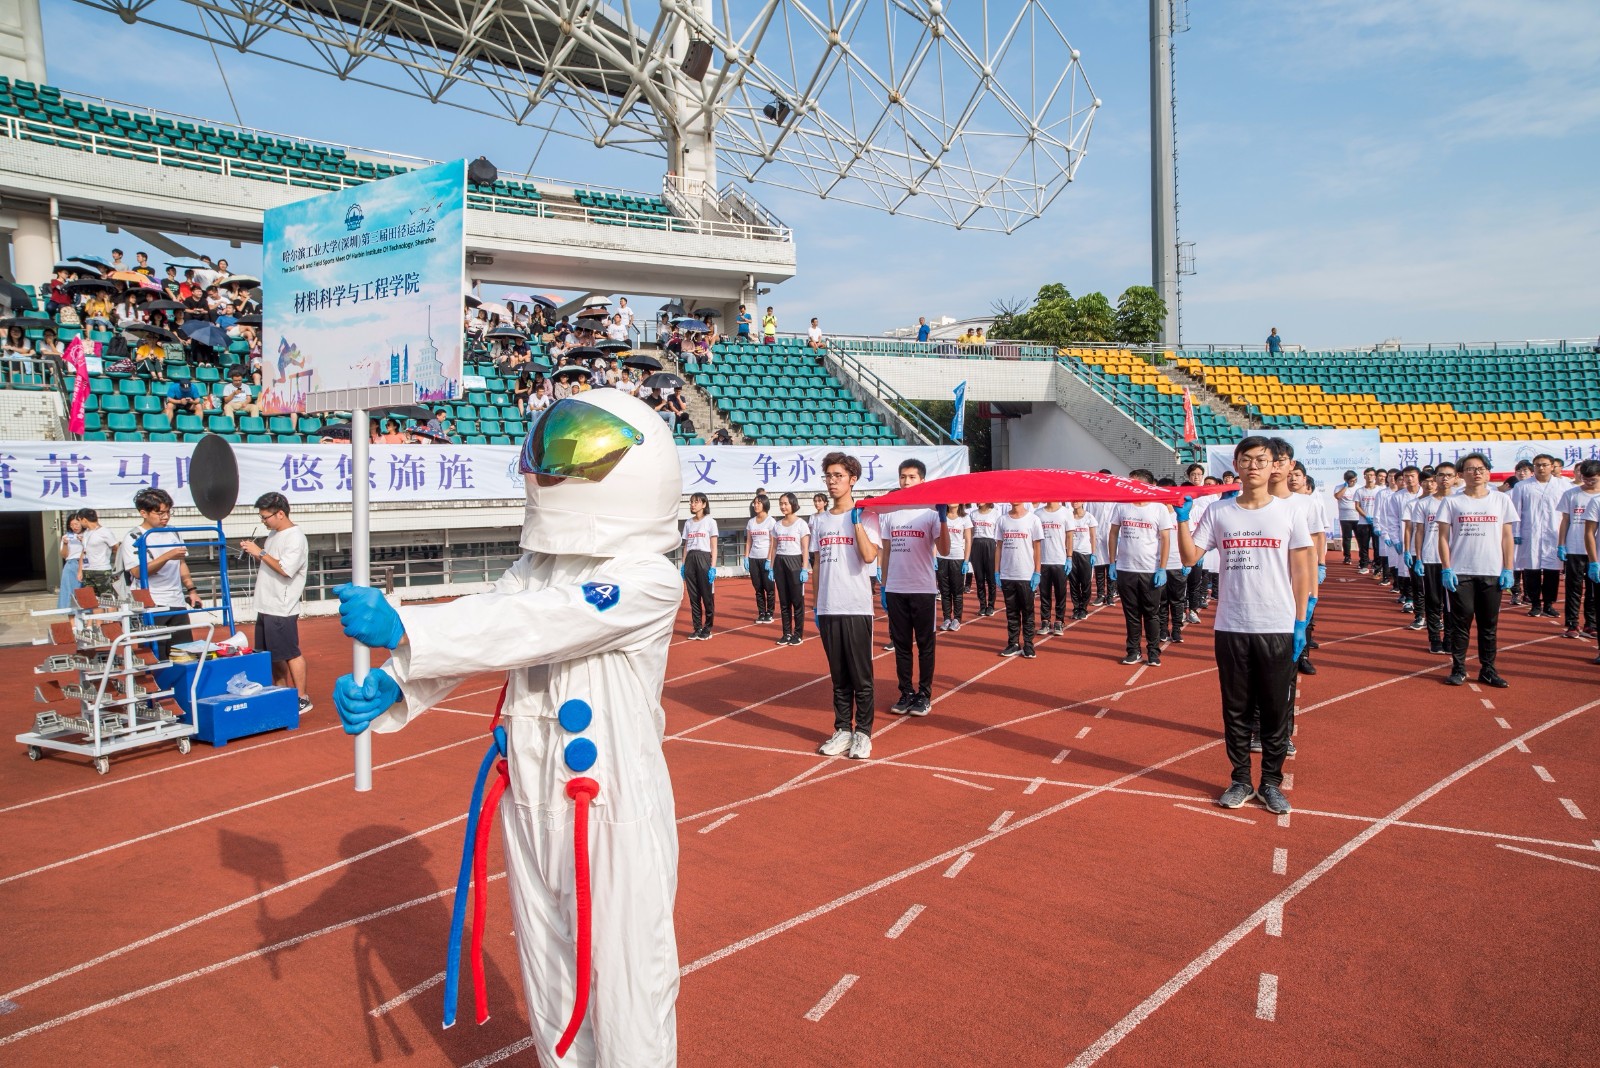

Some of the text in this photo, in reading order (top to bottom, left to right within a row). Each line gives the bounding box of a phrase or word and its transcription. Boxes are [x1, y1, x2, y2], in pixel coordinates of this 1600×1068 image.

[282, 218, 436, 263] 哈尔滨工业大学(深圳)第三届田径运动会
[323, 257, 335, 266] Sports
[335, 255, 346, 263] Meet
[352, 250, 365, 259] Harbin
[365, 247, 383, 256] Institute
[415, 236, 437, 247] Shenzhen
[294, 271, 420, 314] 材料科学与工程学院
[752, 453, 883, 485] 争亦子
[1081, 474, 1111, 484] and
[1225, 539, 1280, 548] MATERIALS
